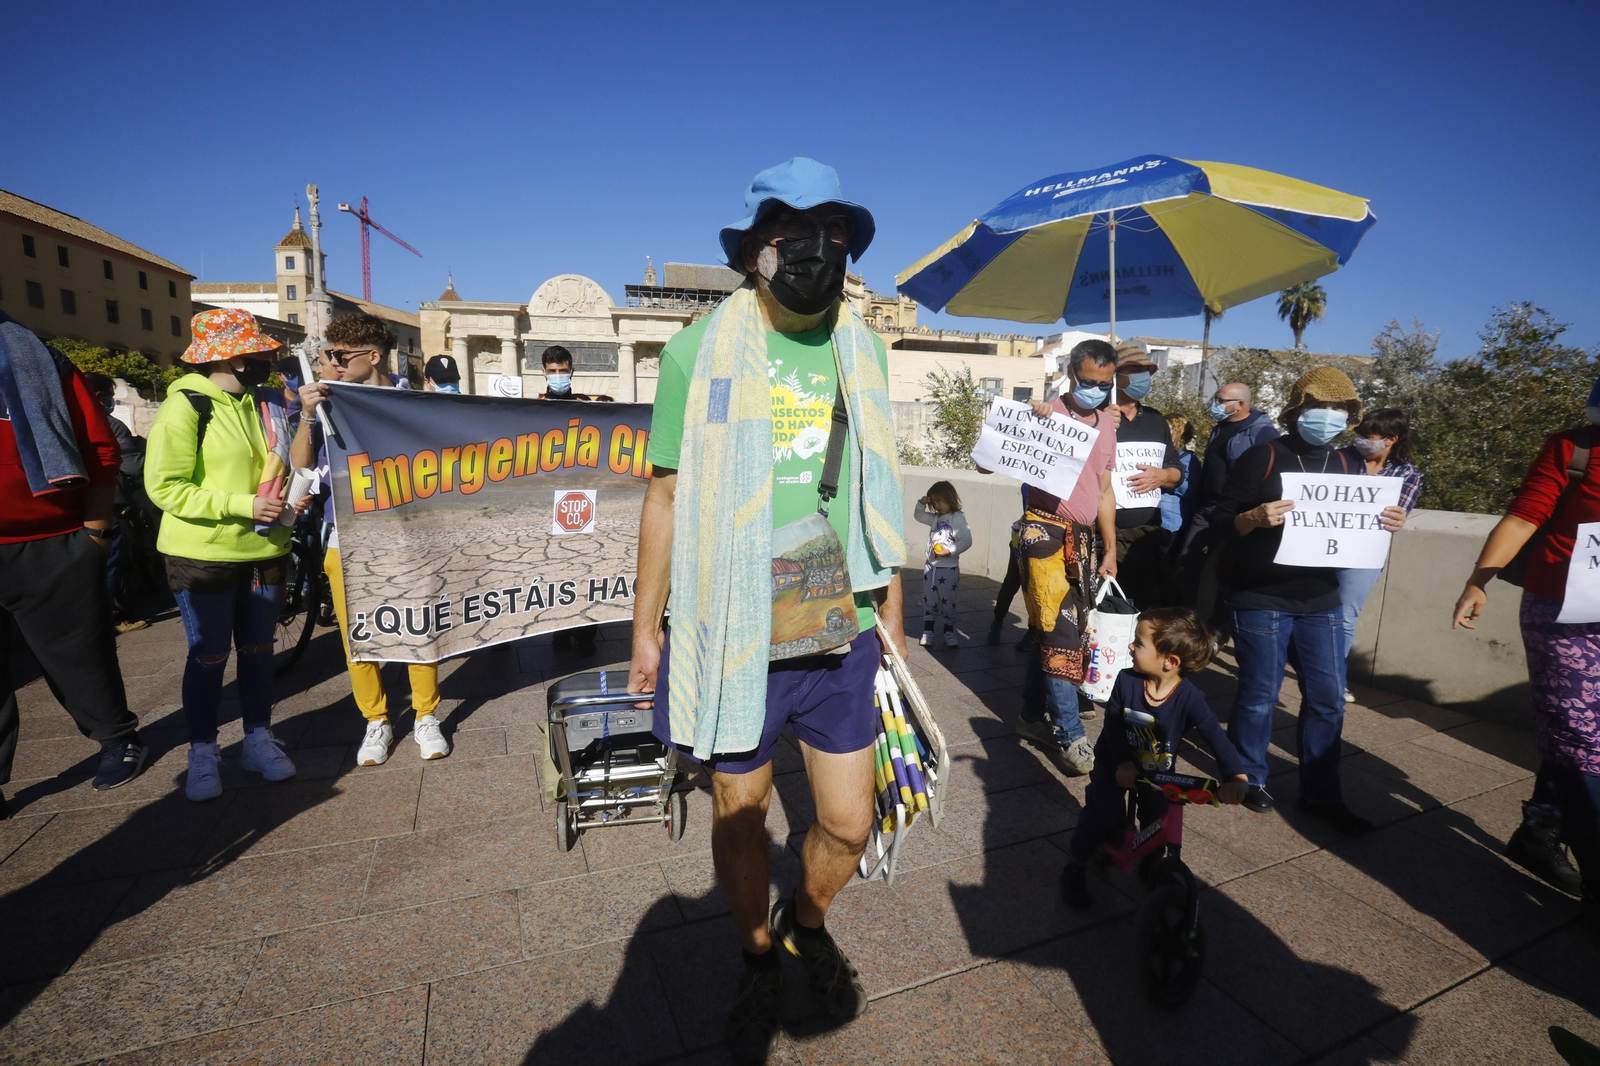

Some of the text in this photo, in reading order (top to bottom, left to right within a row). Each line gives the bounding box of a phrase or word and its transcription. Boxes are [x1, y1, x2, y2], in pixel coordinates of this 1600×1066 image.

[1024, 159, 1162, 197] HELLMANN'S
[771, 396, 785, 406] IN
[771, 408, 826, 418] NSECTOS
[772, 420, 785, 430] O
[996, 405, 1089, 443] NI UN GRADO
[772, 432, 797, 444] IDA
[995, 422, 1075, 458] MÁS NI UNA
[1000, 439, 1058, 467] ESPECIE
[347, 417, 602, 515] Emergencia
[998, 455, 1048, 480] MENOS
[1299, 484, 1382, 504] NO HAY
[560, 499, 588, 513] STOP
[1291, 510, 1384, 531] PLANETA
[1325, 538, 1339, 555] B
[351, 575, 637, 641] ¿QUÉ ESTÁIS HA
[1155, 773, 1196, 785] STRIDER
